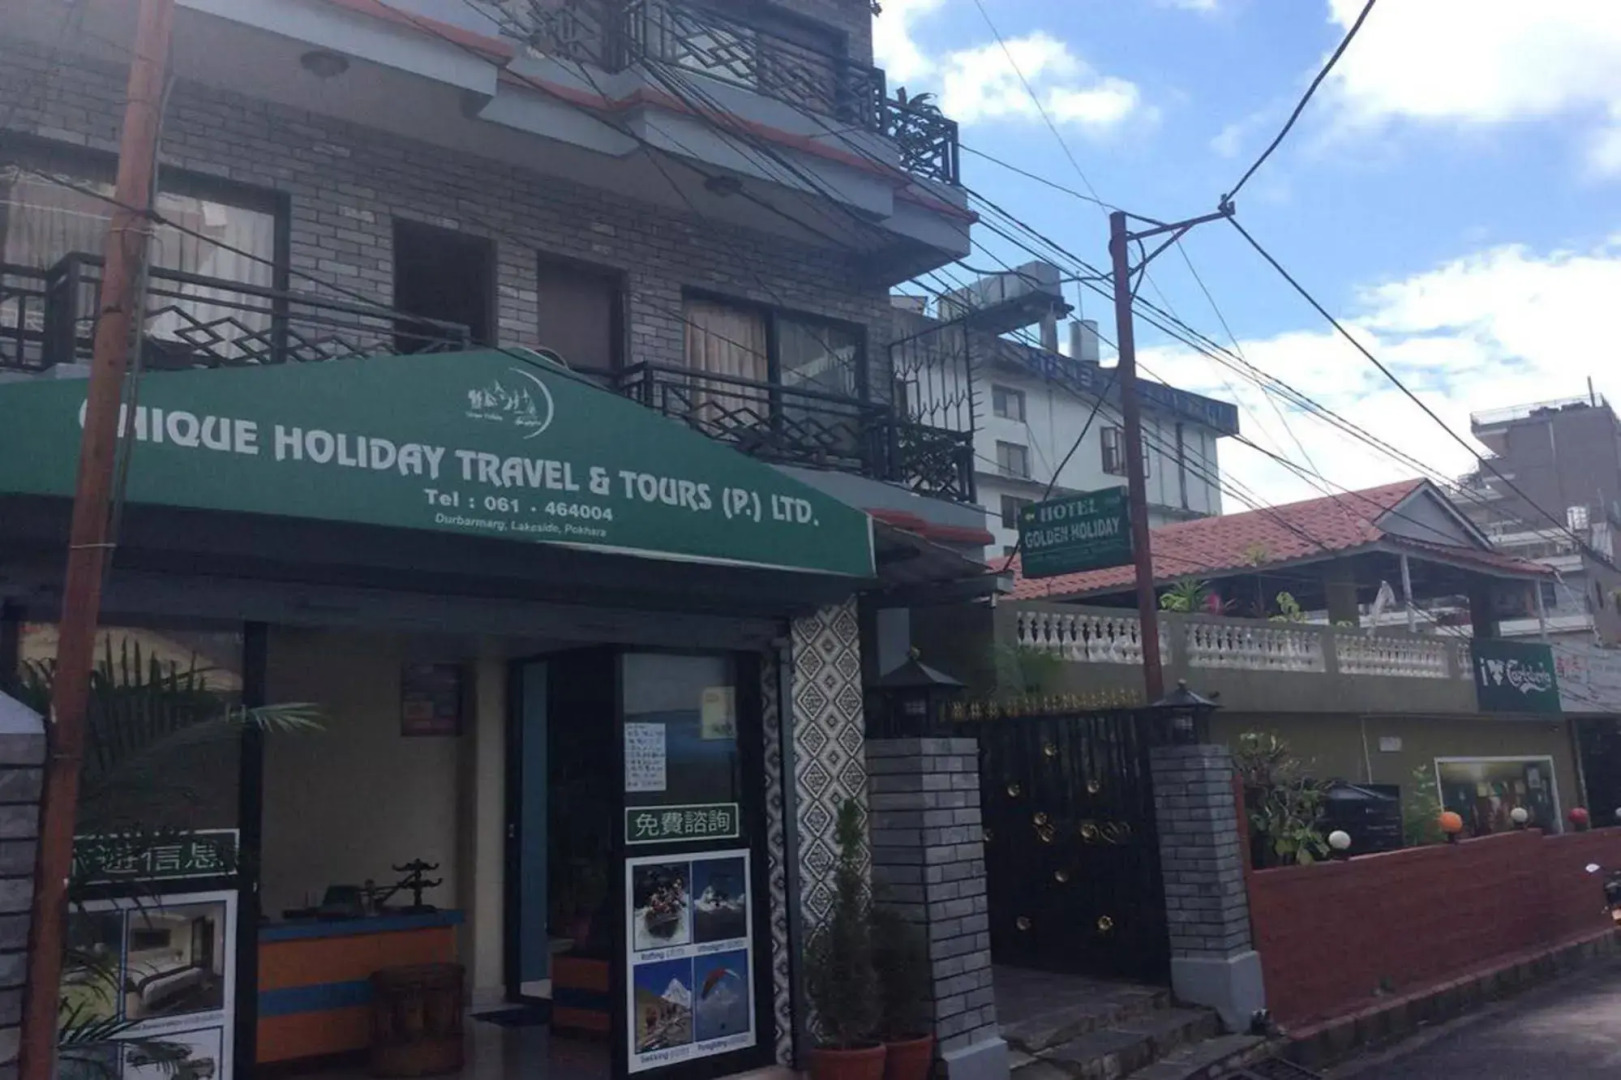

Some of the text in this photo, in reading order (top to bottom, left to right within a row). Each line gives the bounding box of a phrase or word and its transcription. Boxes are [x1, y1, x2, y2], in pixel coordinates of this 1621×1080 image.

[79, 398, 259, 455] NIQUE
[275, 424, 445, 480] HOLIDAY
[455, 449, 579, 492] TRAVEL
[588, 466, 610, 496] &
[619, 470, 711, 512] TOURS
[772, 494, 819, 527] LTD.
[424, 489, 459, 508] Tel
[484, 496, 519, 513] 061
[545, 501, 613, 521] 464004
[1040, 498, 1098, 523] HOTEL
[1025, 517, 1120, 549] GOLDEN HOLIDAY
[635, 809, 731, 837] 免費諮詢
